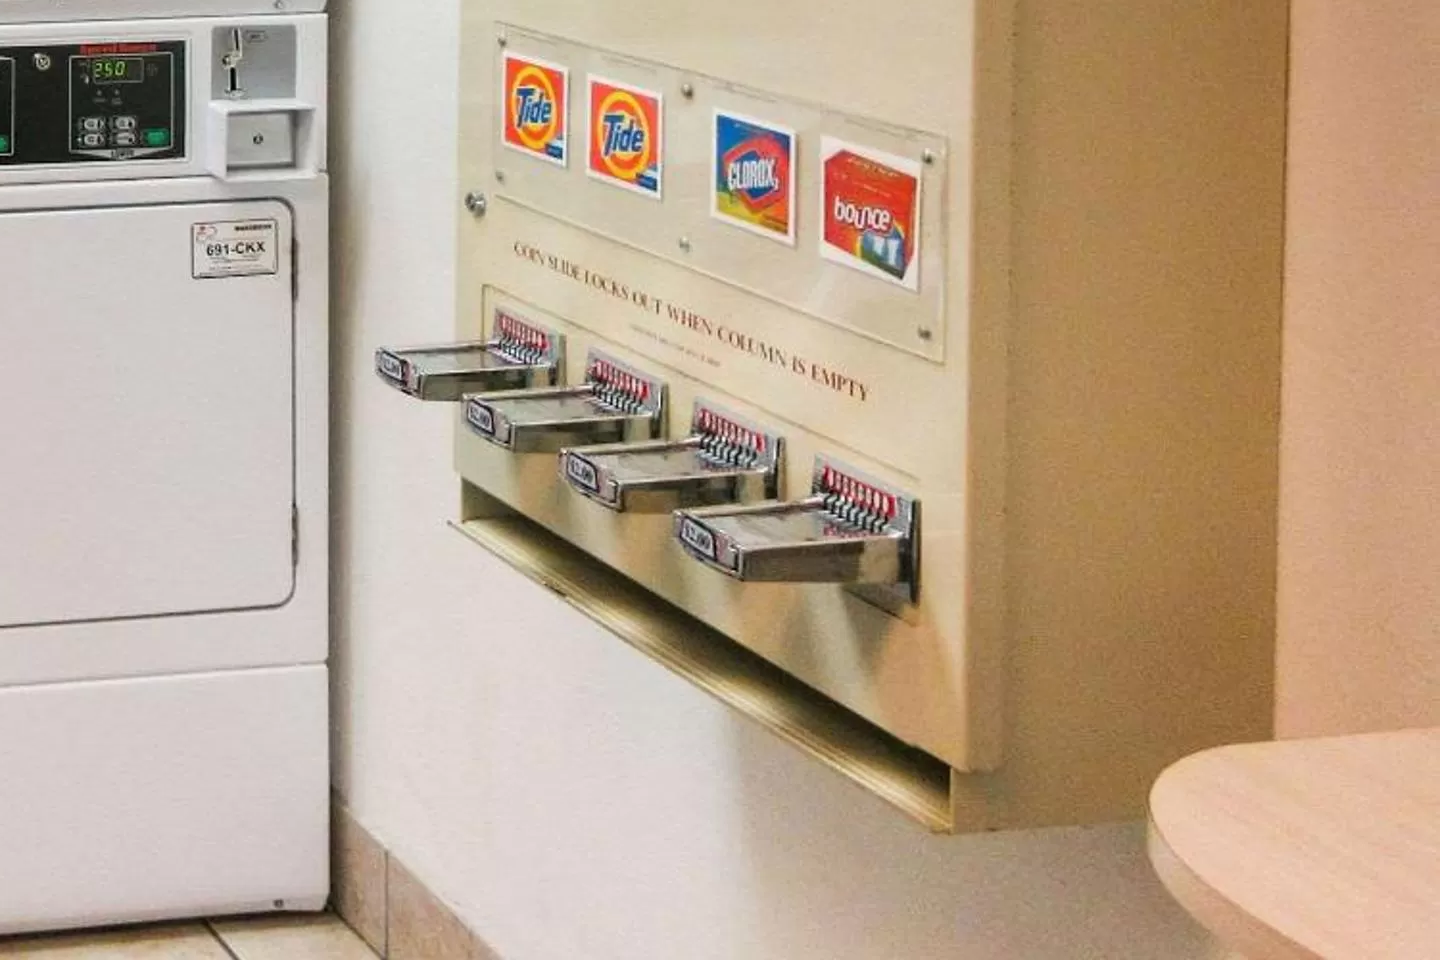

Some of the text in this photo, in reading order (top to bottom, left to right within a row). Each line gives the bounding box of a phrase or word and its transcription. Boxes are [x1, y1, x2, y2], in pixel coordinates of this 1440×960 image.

[94, 61, 126, 78] 250
[516, 87, 552, 128] Tide
[603, 115, 645, 157] Tide
[834, 195, 892, 231] bounce
[206, 240, 266, 257] 691-CKX
[514, 241, 545, 265] COIN
[548, 255, 581, 281] SLIDE
[583, 270, 630, 300] LOCKS
[632, 290, 662, 315] OUT
[666, 304, 714, 336] WHEN
[717, 325, 788, 368] COLUMN
[792, 355, 806, 375] IS
[811, 363, 870, 402] EMPTY
